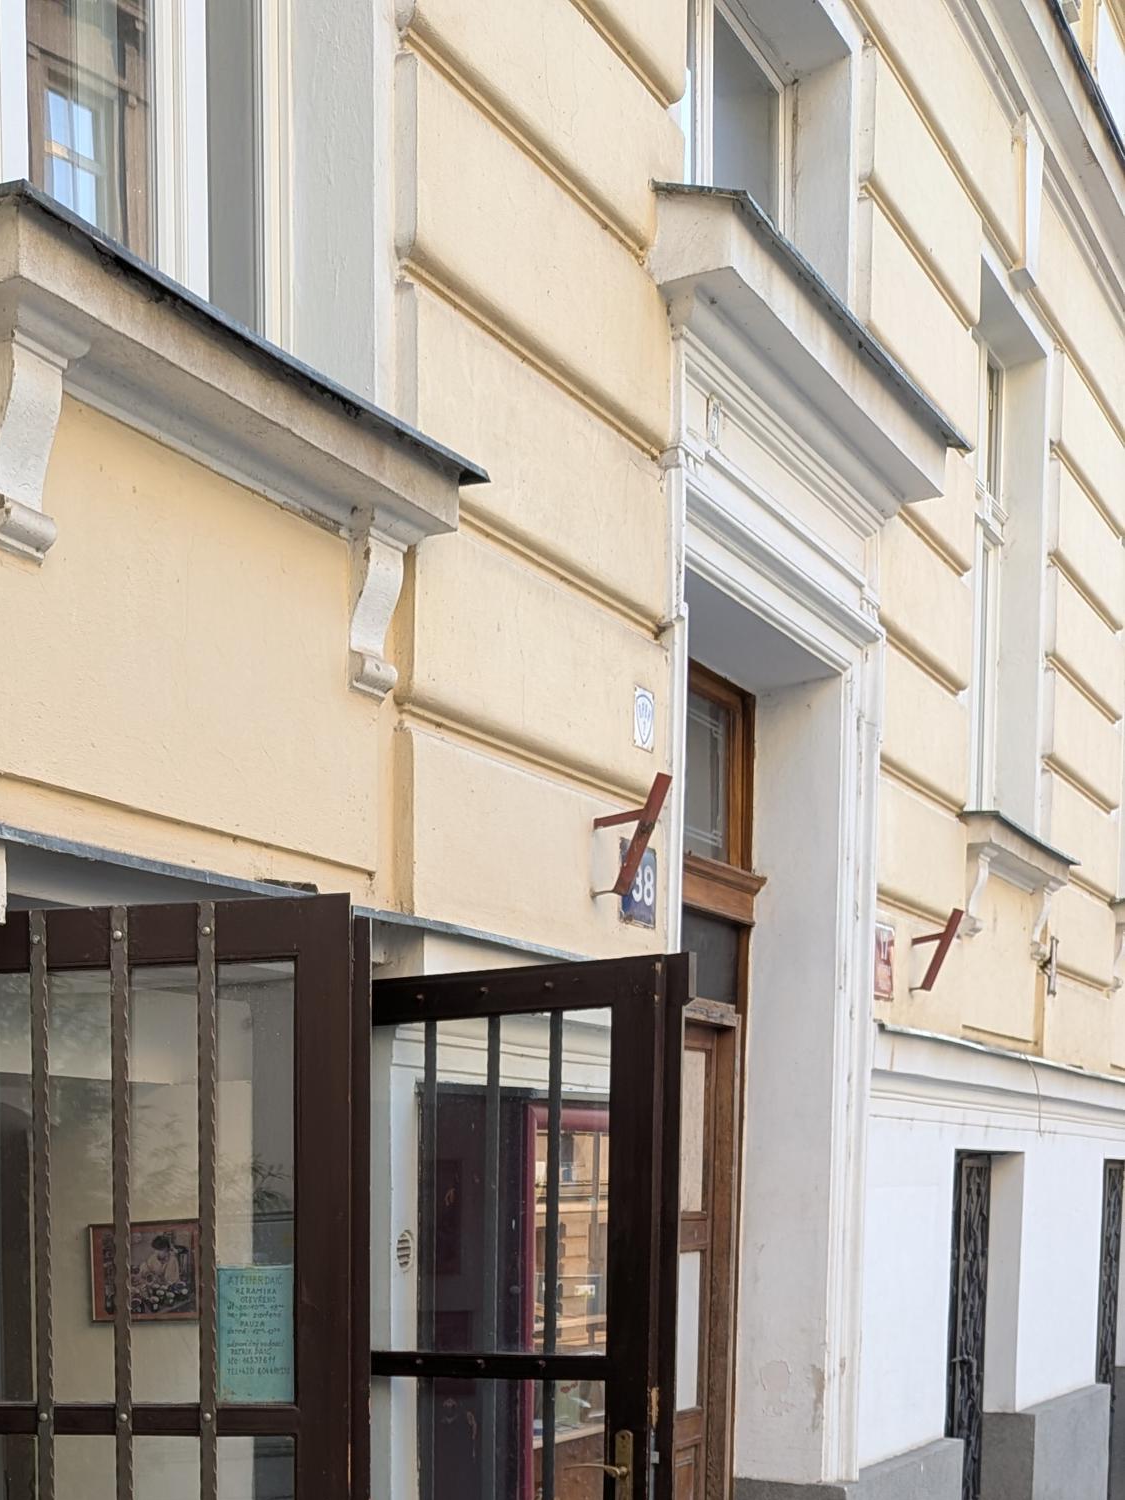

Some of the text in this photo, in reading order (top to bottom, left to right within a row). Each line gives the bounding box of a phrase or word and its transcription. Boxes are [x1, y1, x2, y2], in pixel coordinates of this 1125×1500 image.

[631, 865, 655, 906] 38
[236, 1287, 277, 1296] KERAMIKA
[239, 1320, 265, 1328] PAUZA
